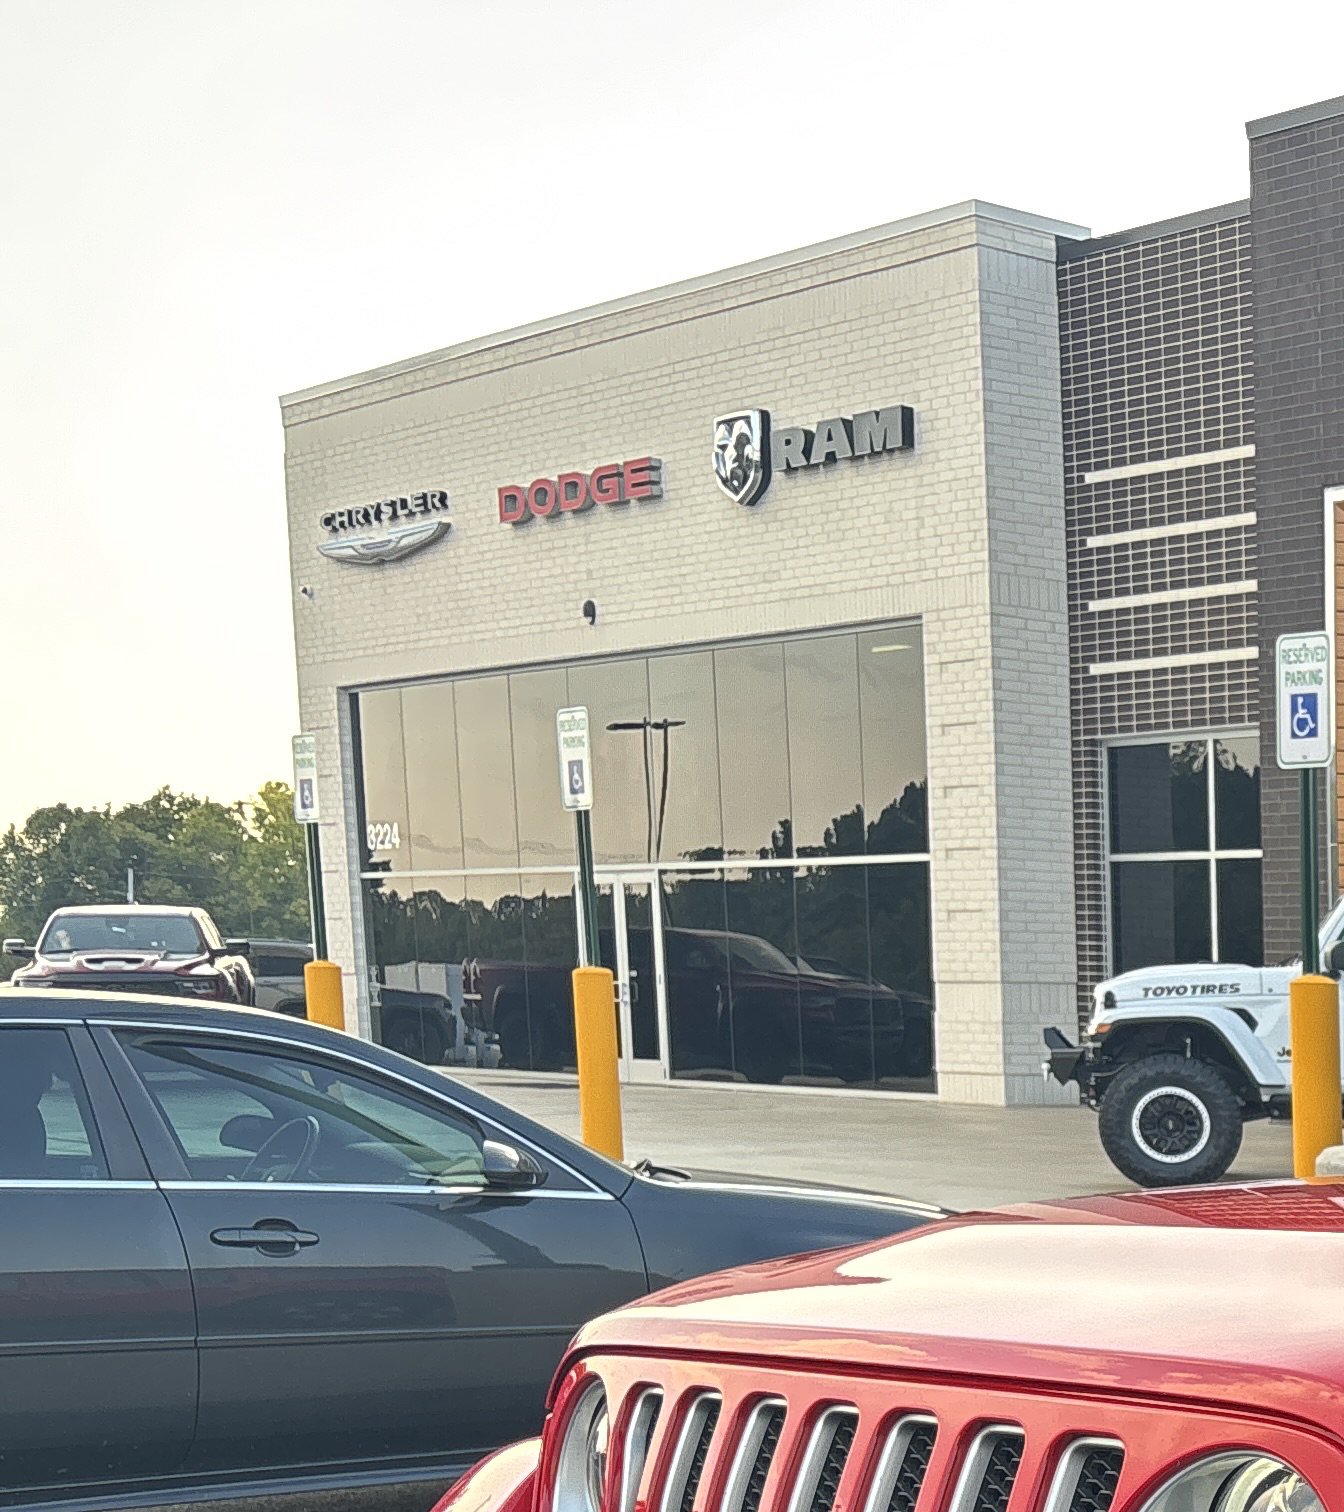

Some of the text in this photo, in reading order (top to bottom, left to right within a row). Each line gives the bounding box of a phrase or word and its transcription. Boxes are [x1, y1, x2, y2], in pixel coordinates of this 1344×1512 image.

[771, 404, 915, 472] RAM
[498, 456, 662, 525] DODGE
[319, 490, 449, 533] CHRYSLER
[1281, 645, 1327, 664] RESERVED
[1284, 669, 1324, 687] PARKING
[1142, 983, 1241, 998] TOYO TIRES
